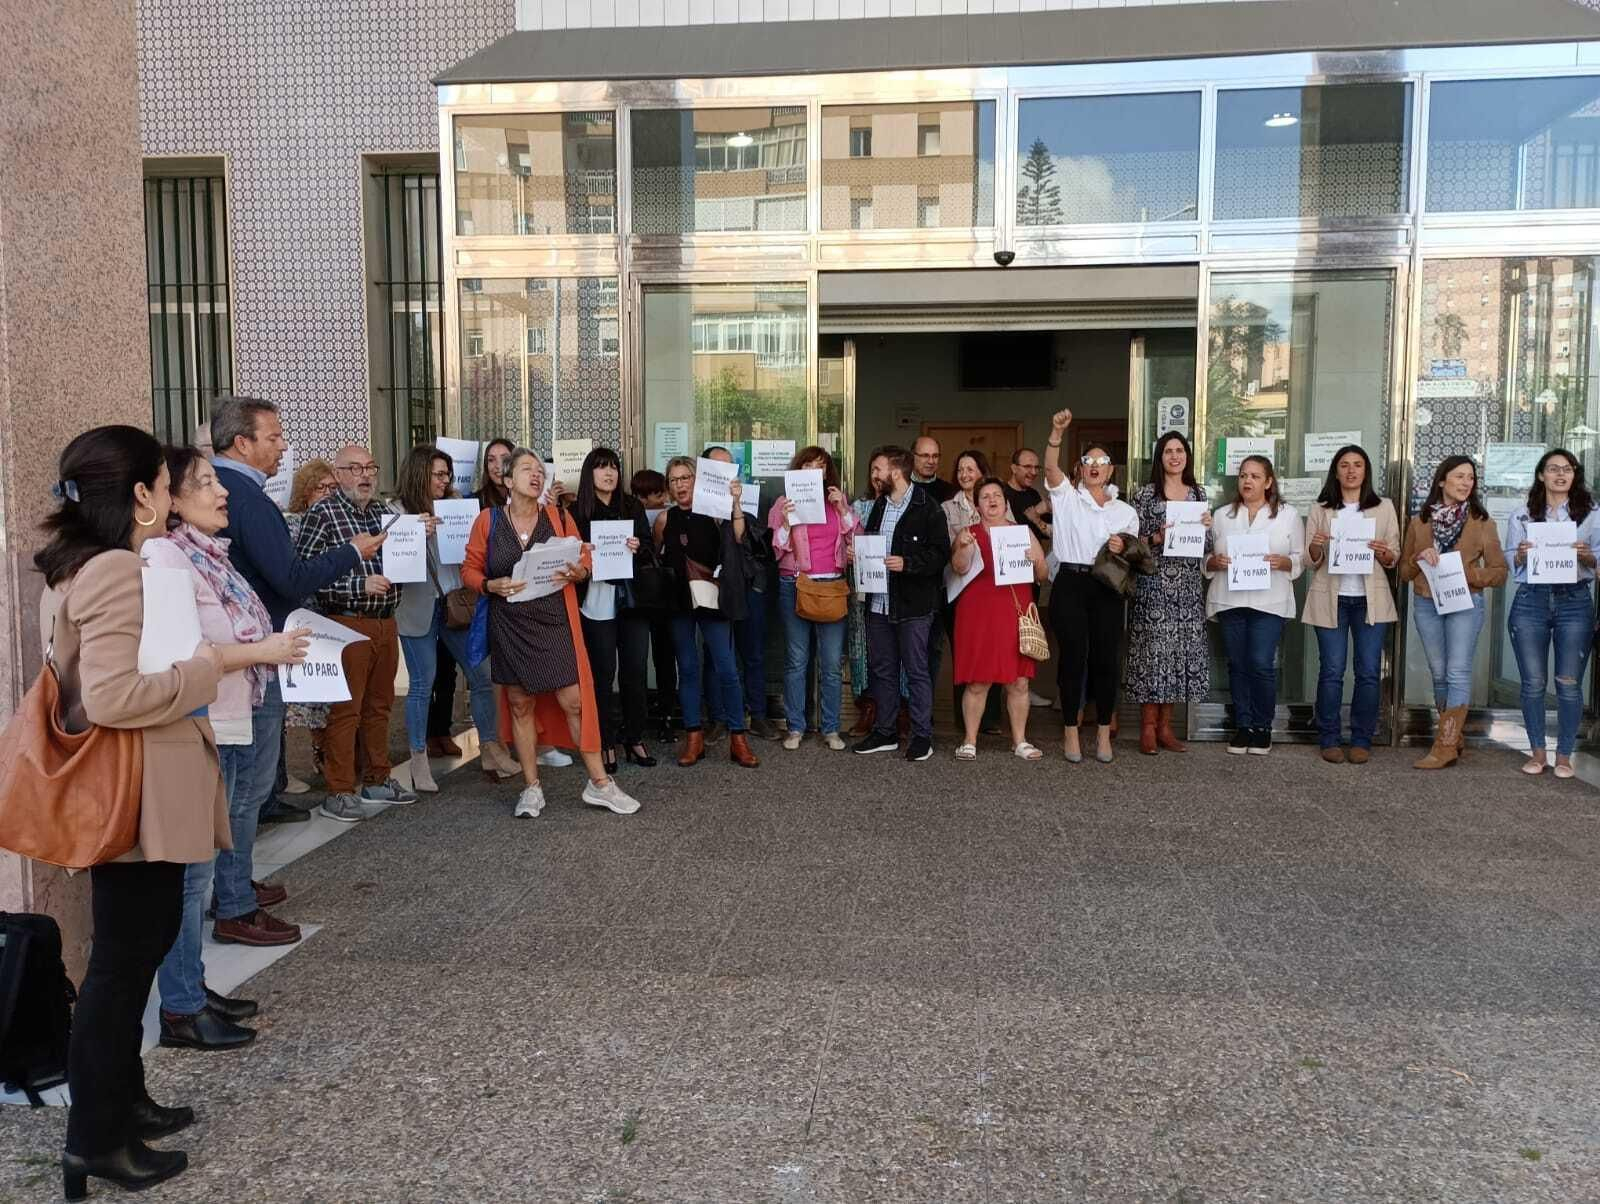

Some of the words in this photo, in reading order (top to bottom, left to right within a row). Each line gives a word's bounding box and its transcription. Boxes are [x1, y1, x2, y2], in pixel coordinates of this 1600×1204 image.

[1179, 536, 1187, 544] YO
[1187, 535, 1202, 544] PARO
[1345, 552, 1354, 561] YO
[1354, 552, 1371, 561] PARO
[1009, 560, 1016, 568] YO
[1017, 559, 1032, 568] PARO
[1545, 560, 1554, 569] YO
[1555, 560, 1574, 569] PARO
[872, 571, 884, 579] PARO
[1243, 569, 1251, 577] YO
[1252, 568, 1268, 576] PARO
[1443, 590, 1451, 600] YO
[1451, 587, 1466, 599] PARO
[302, 662, 313, 677] YO
[316, 663, 338, 677] PARO
